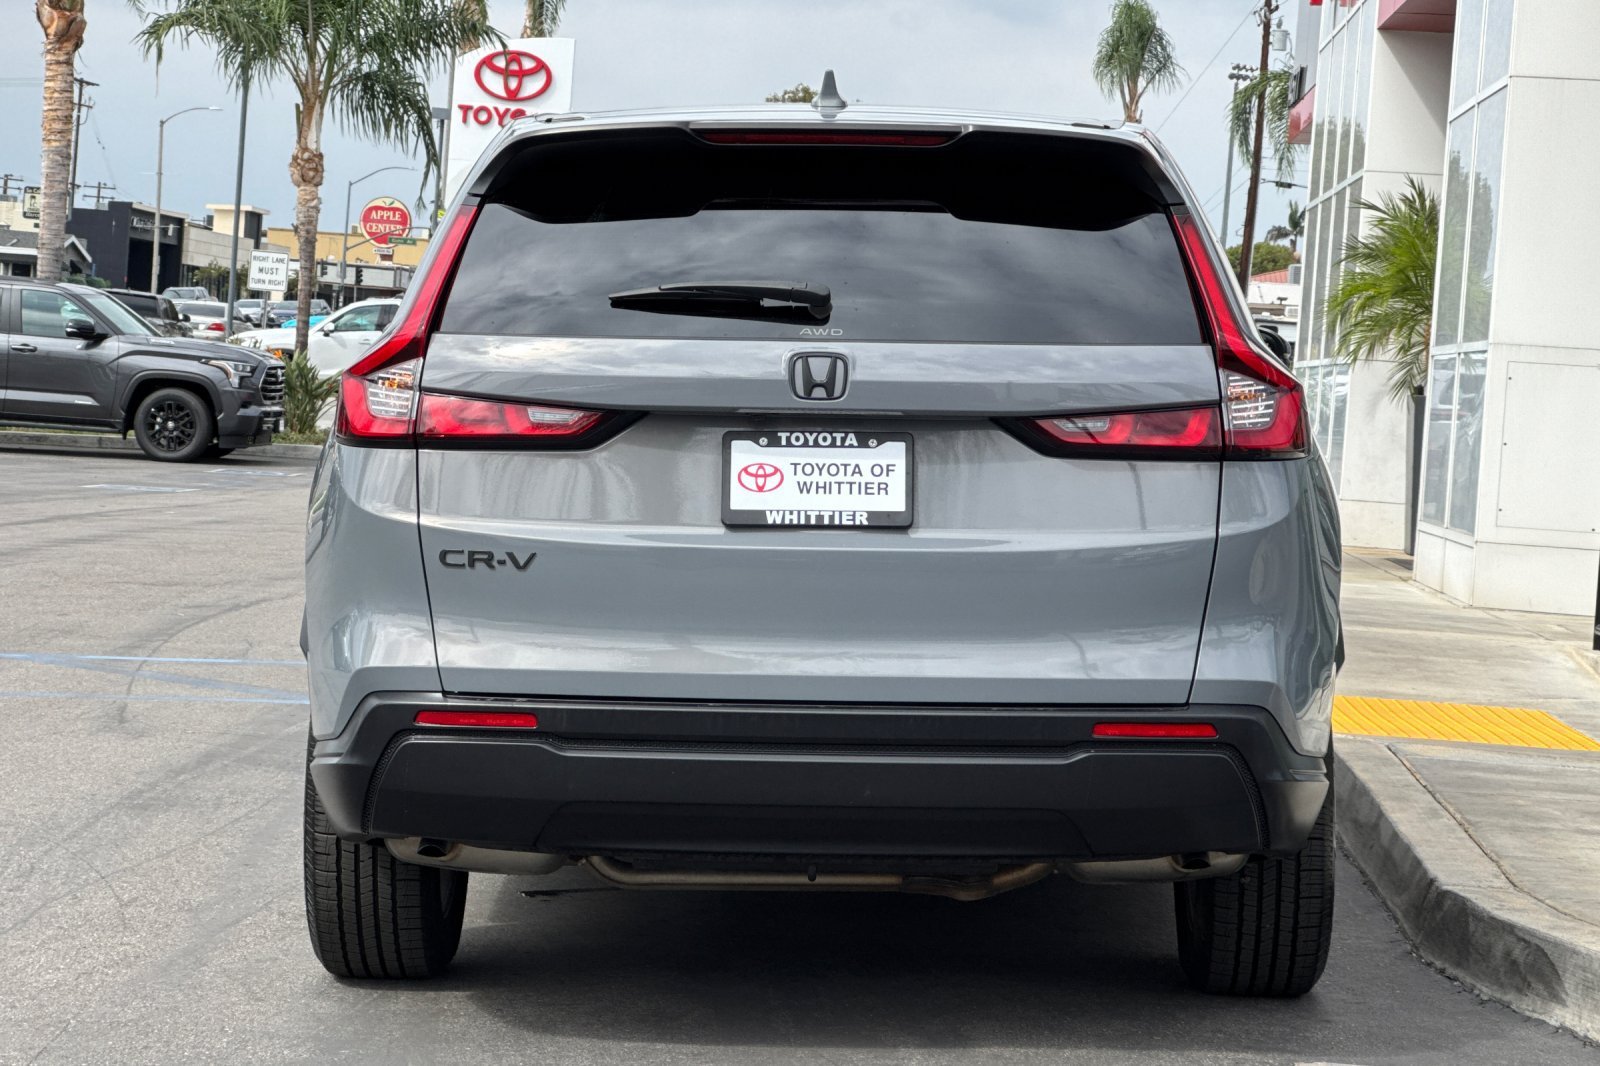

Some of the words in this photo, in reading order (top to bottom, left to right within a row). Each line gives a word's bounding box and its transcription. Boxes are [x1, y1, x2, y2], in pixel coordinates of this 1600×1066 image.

[370, 210, 402, 221] APPLE
[366, 222, 403, 235] CENTER
[258, 266, 279, 275] MUST
[251, 278, 266, 286] TURN
[799, 328, 844, 336] AWD
[777, 432, 859, 447] TOYOTA
[790, 462, 864, 477] TOYOTA
[870, 463, 897, 478] OF
[796, 480, 889, 496] WHITTIER
[765, 510, 869, 526] WHITTIER
[438, 549, 538, 571] CR-V
